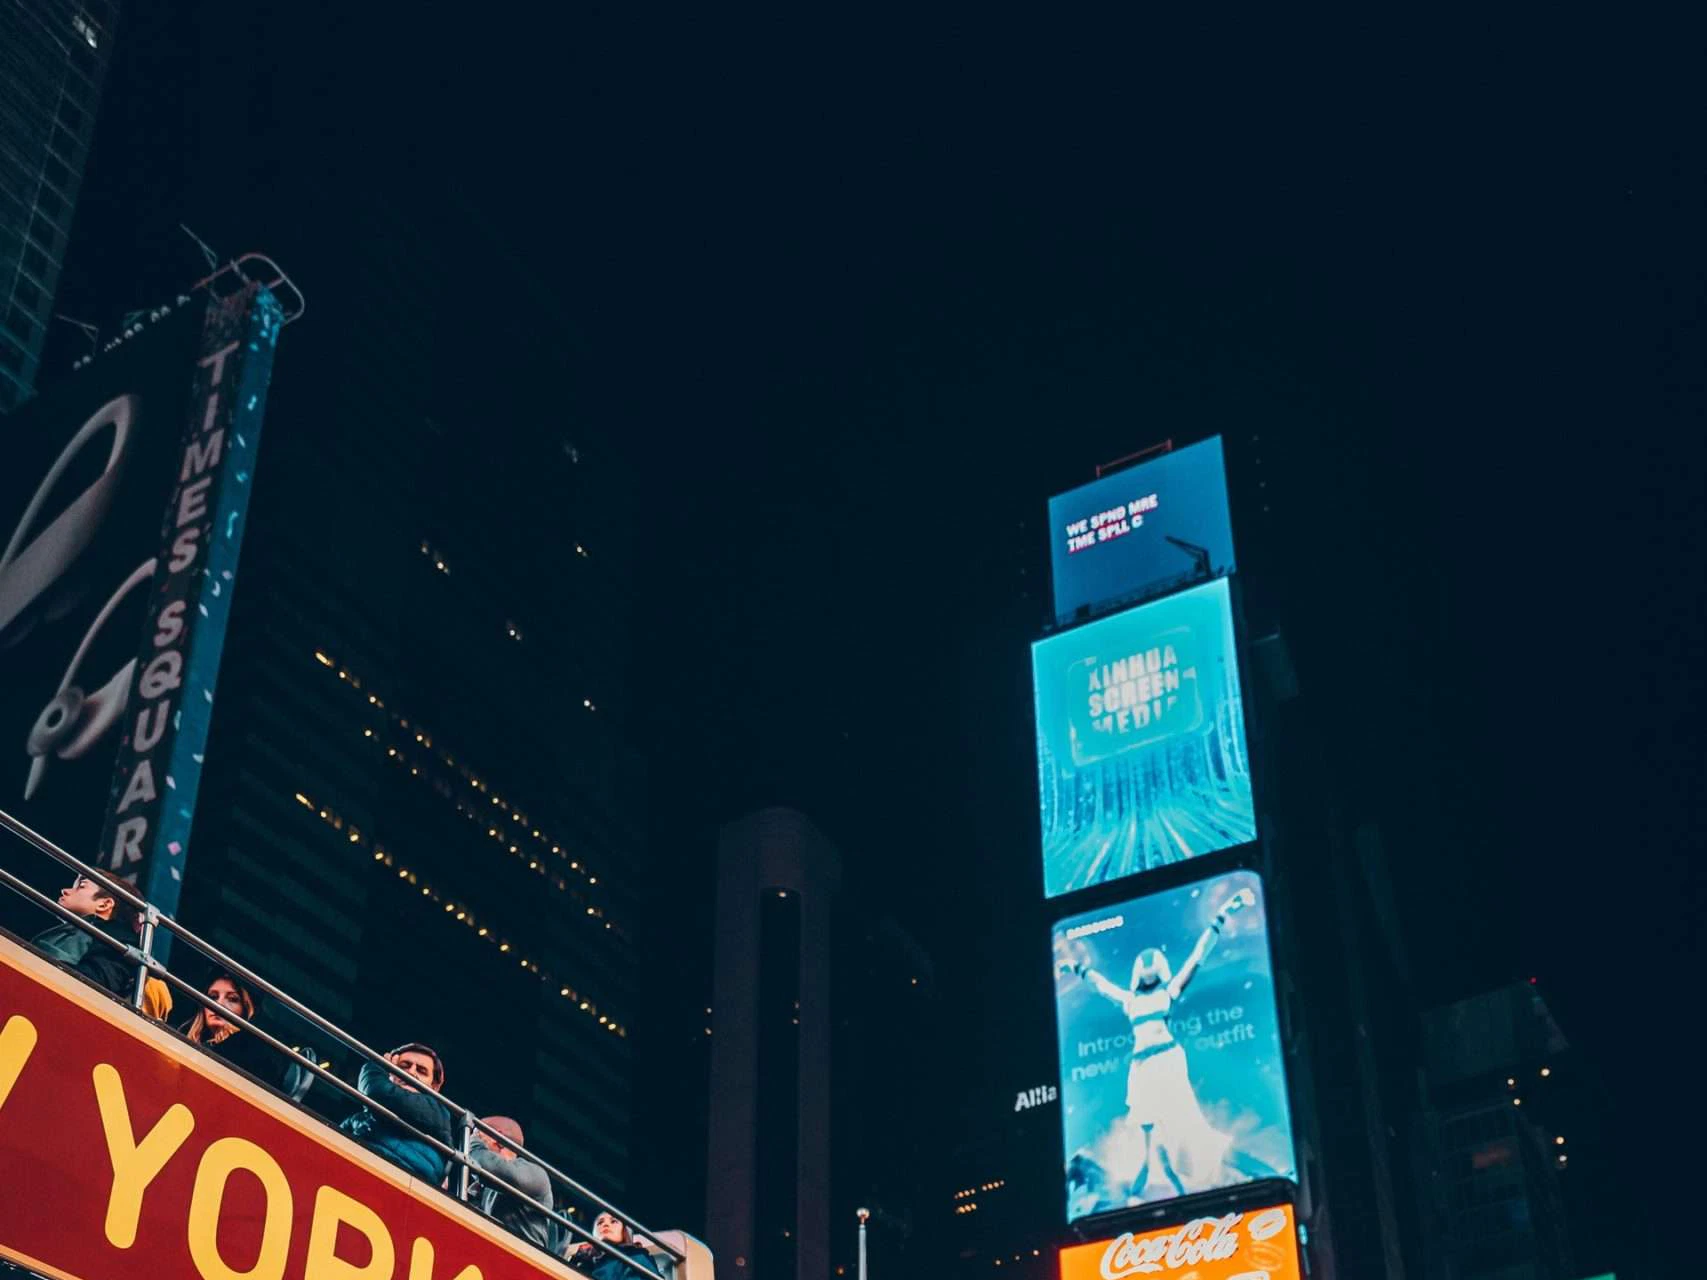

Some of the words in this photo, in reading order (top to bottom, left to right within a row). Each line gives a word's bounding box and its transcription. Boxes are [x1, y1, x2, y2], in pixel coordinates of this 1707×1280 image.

[169, 340, 240, 572] TIMES
[111, 599, 187, 885] SQUAR
[1071, 1056, 1120, 1084] new
[1194, 1023, 1257, 1053] outfit
[1205, 1005, 1244, 1026] the
